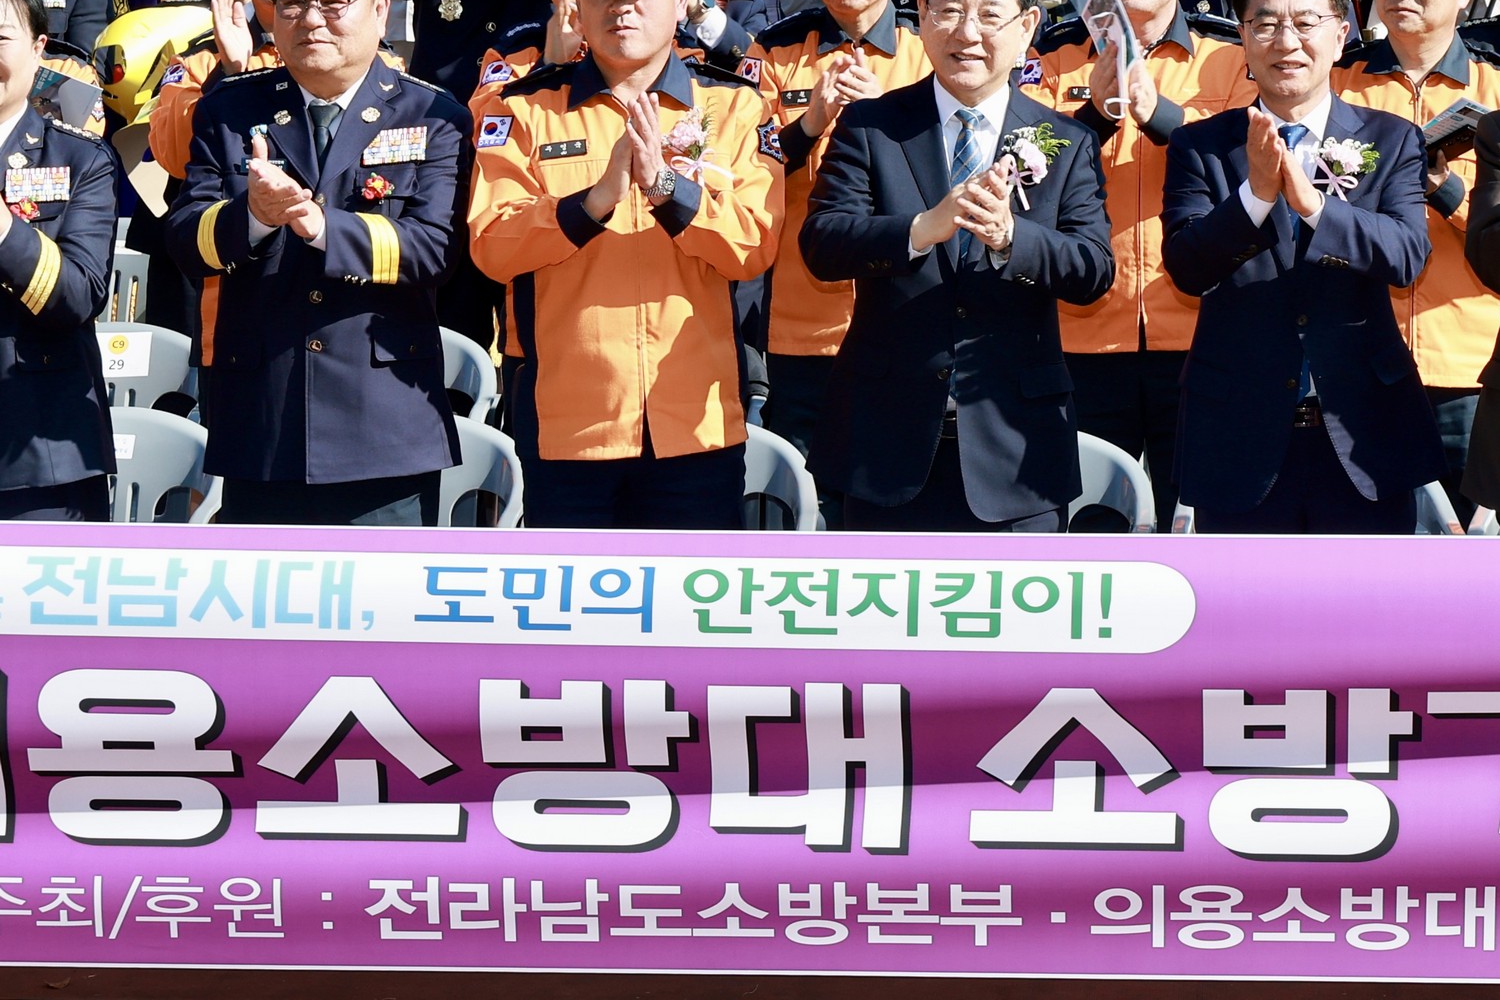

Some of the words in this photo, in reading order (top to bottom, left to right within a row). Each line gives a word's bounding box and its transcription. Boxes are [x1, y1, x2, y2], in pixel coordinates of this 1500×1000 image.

[109, 360, 125, 371] 29
[112, 340, 125, 350] C9
[24, 556, 376, 631] 전남시대,
[414, 565, 656, 634] 도민의
[682, 567, 1113, 640] 안전지킴이!
[0, 667, 912, 854] 용소방대
[364, 875, 1023, 948] 전라남도소방본부
